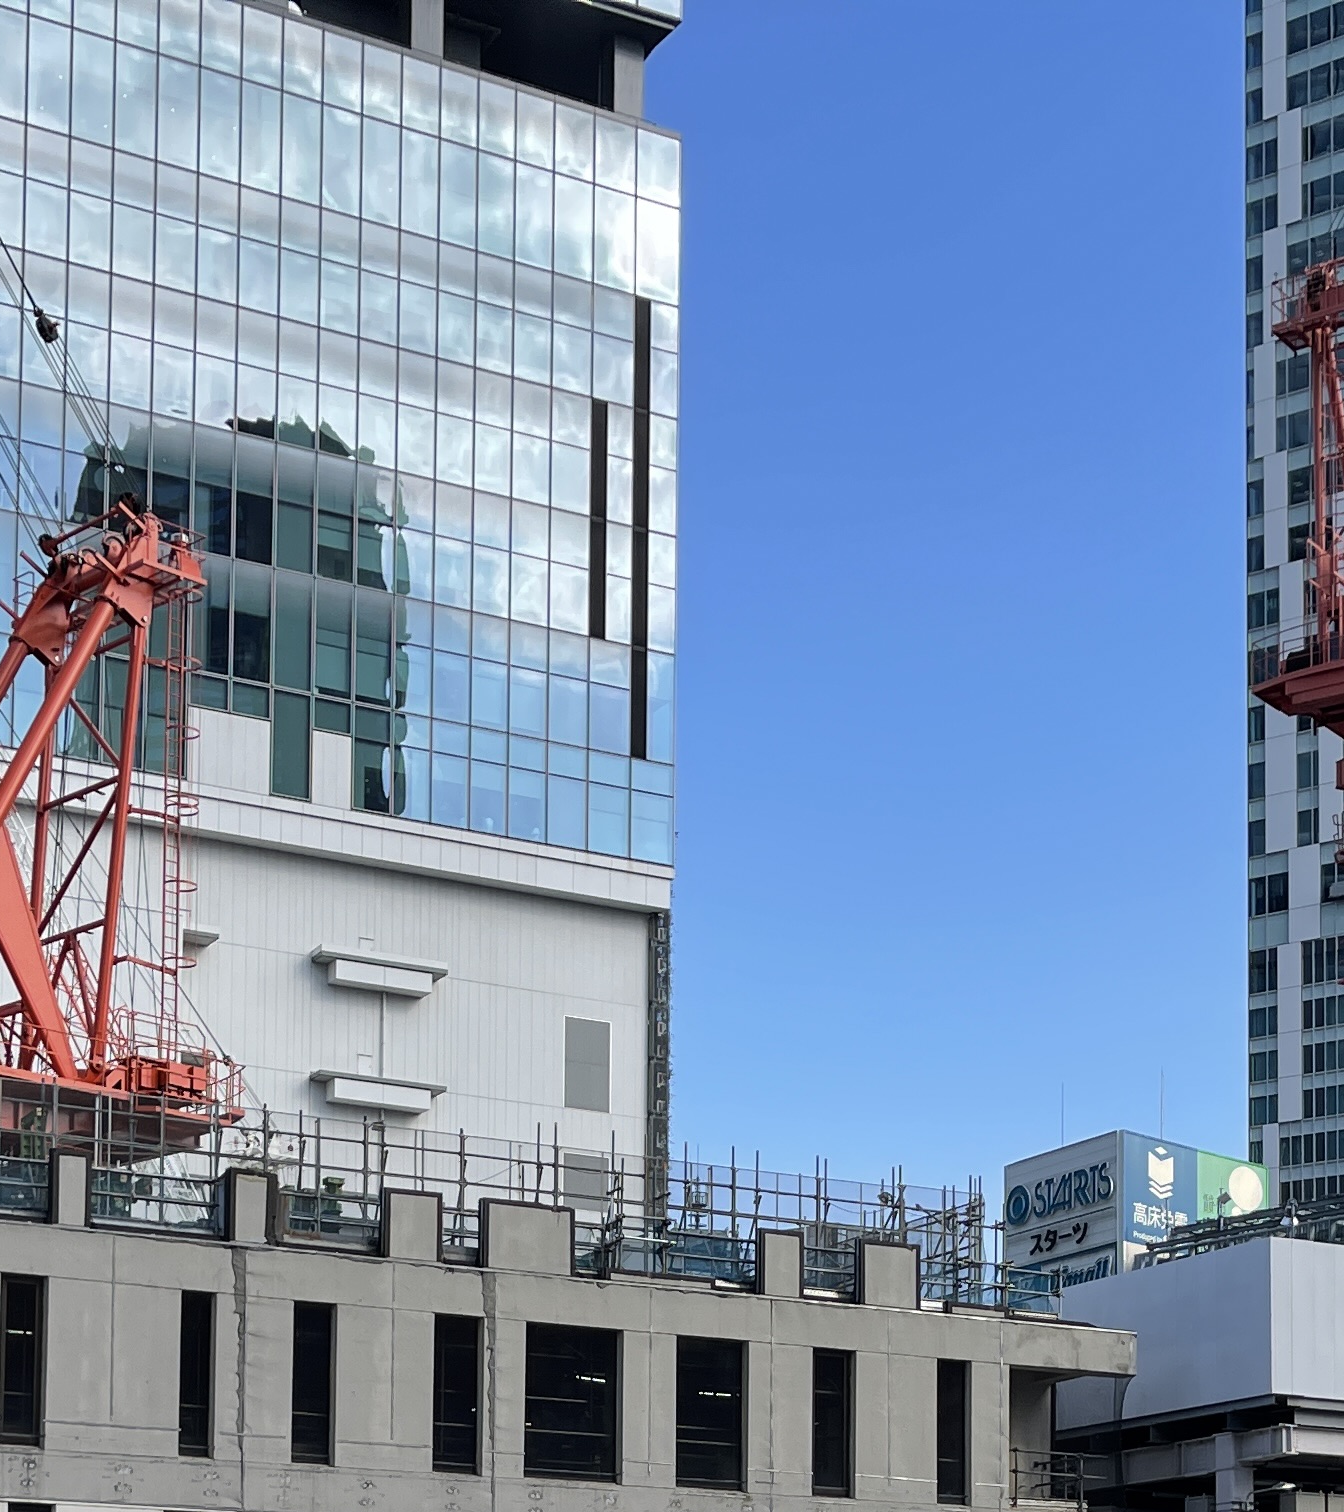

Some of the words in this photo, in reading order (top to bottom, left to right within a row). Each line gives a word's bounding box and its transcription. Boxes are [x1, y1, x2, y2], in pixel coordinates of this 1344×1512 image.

[1033, 1161, 1115, 1220] STARTS
[1029, 1222, 1089, 1256] スターツ
